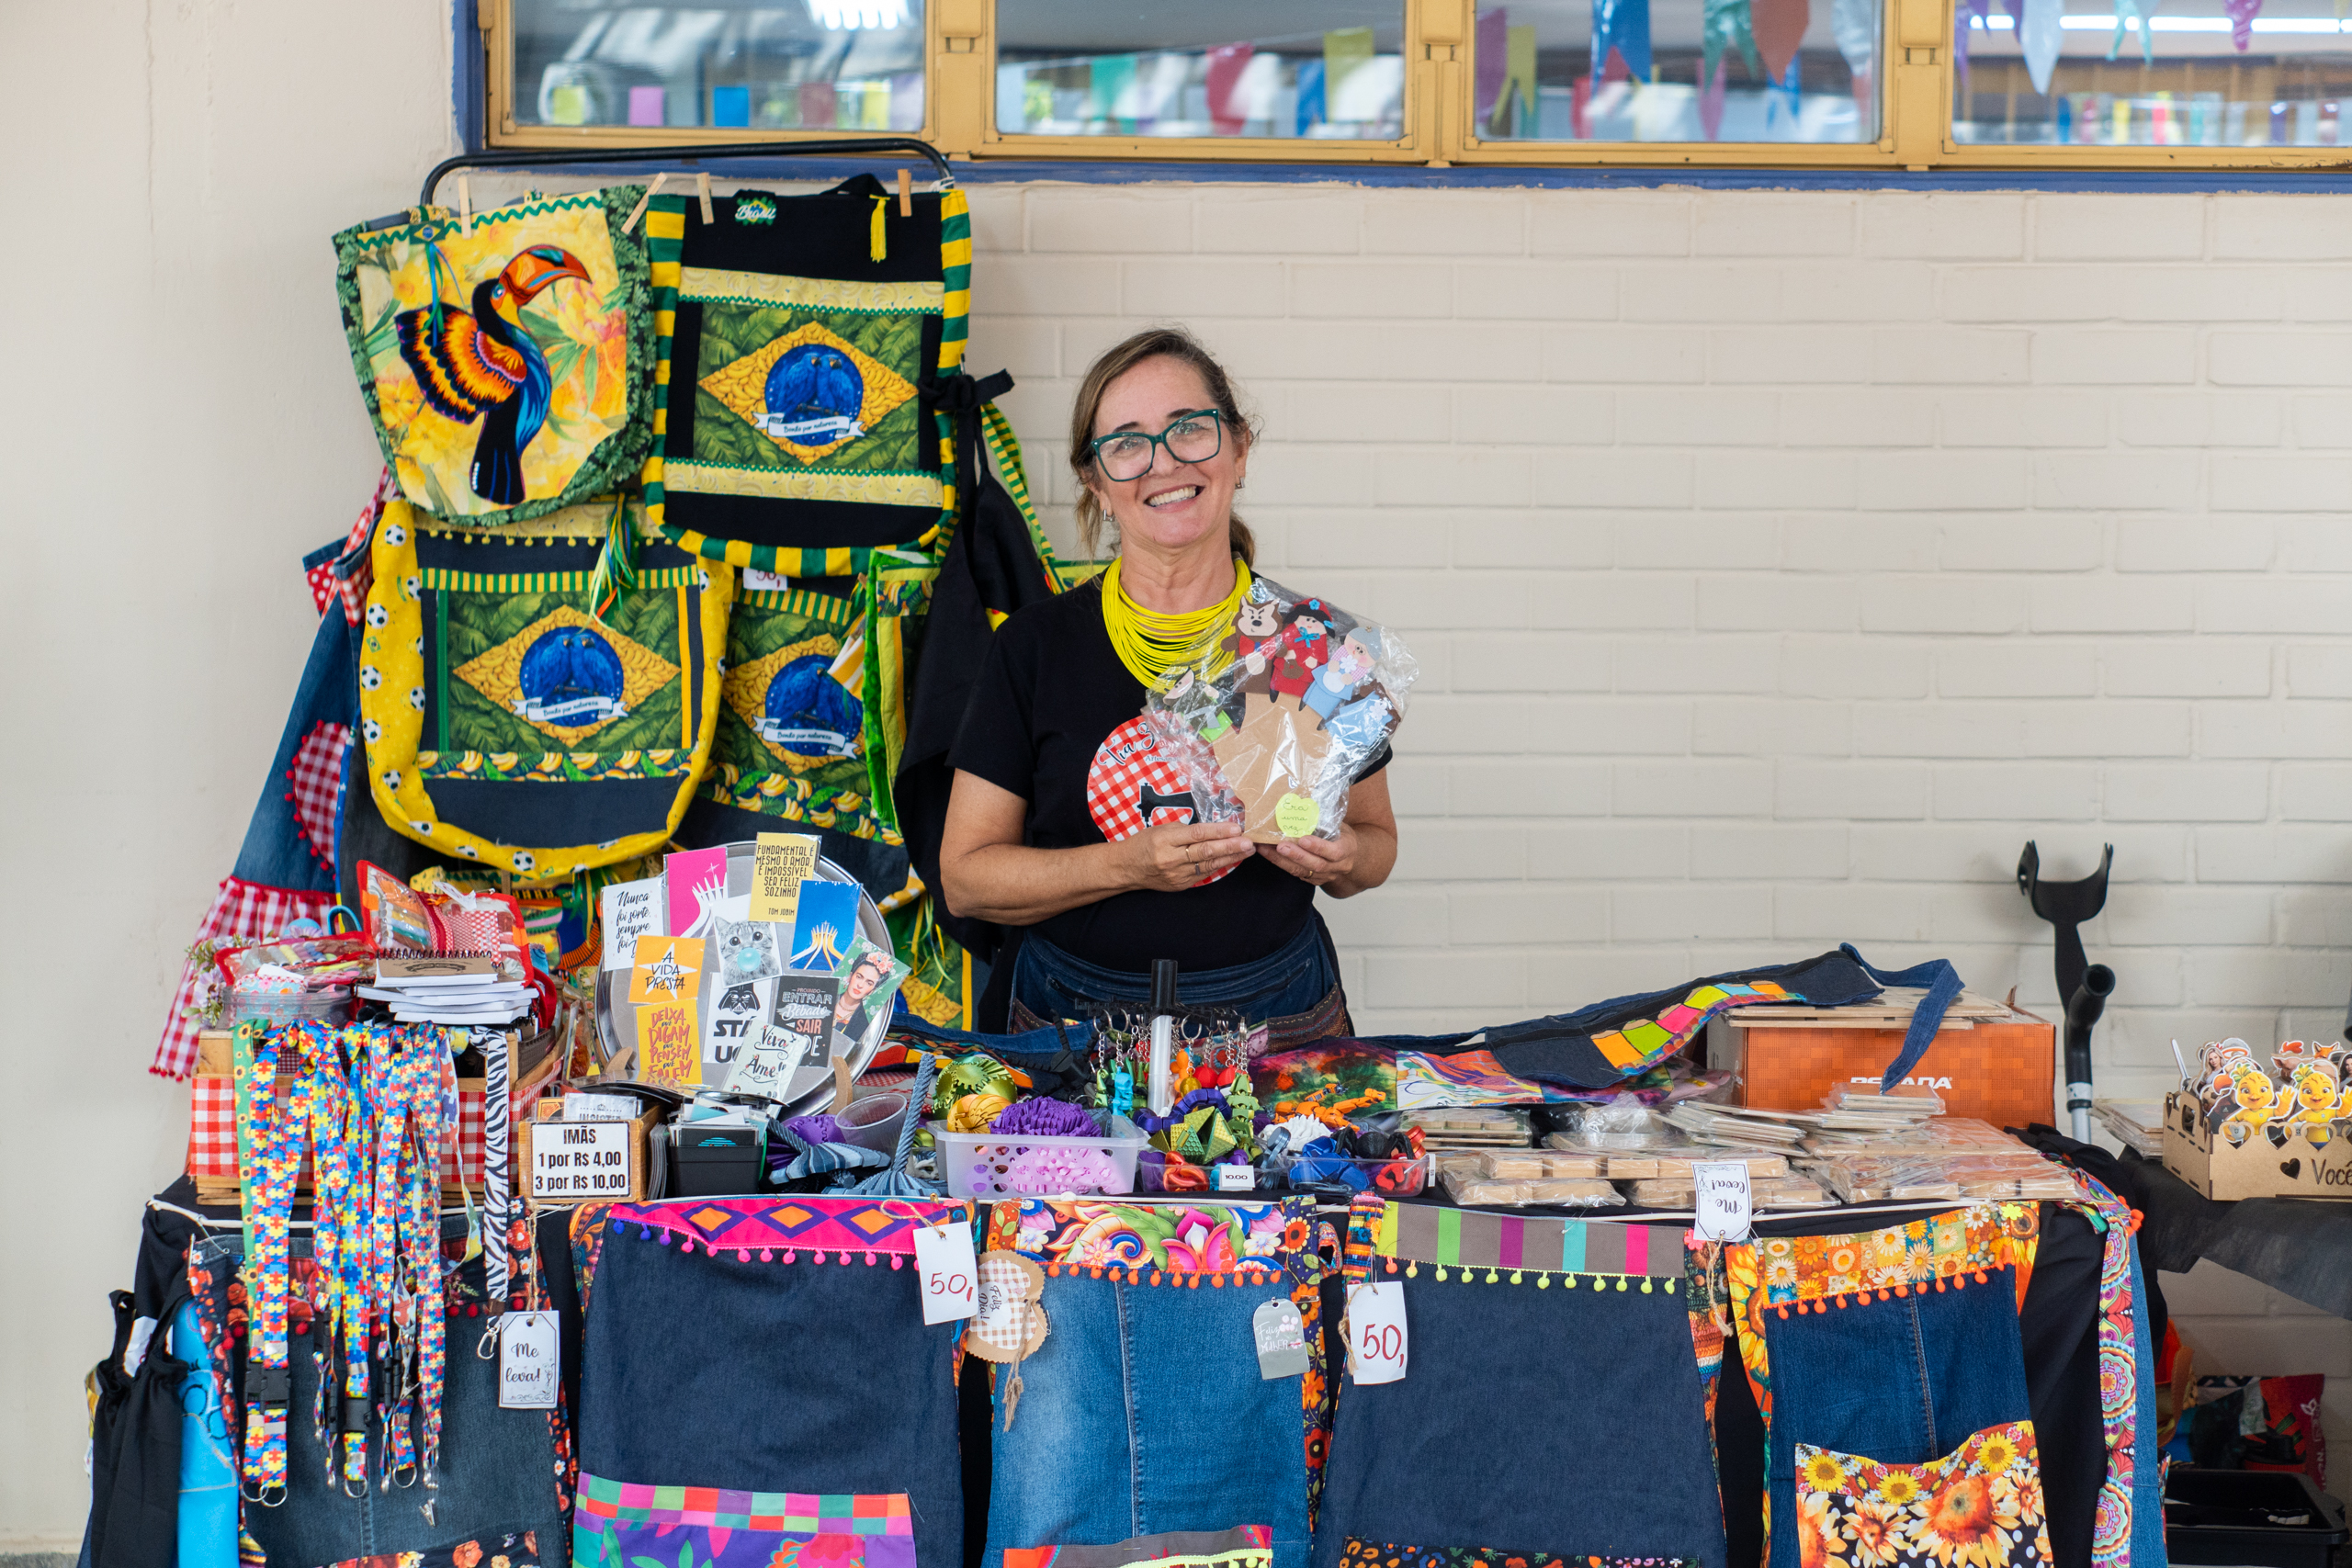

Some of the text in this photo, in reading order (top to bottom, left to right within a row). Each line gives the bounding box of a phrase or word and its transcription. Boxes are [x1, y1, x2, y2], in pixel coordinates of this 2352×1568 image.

[735, 204, 776, 220] Brasil
[1096, 739, 1136, 766] Tia
[1283, 798, 1308, 811] Era
[1283, 824, 1303, 836] vez
[757, 845, 815, 856] FUNDAMENTAL É
[755, 855, 812, 868] MESMO O AMOR,
[758, 864, 807, 876] É IMPOSSÍVEL
[763, 876, 799, 887] SER FELIZ
[616, 891, 650, 907] Nunca
[764, 886, 797, 897] SOZINHO
[616, 908, 628, 926] foi
[768, 908, 778, 916] TOM
[616, 923, 650, 939] sempre
[617, 936, 628, 953] foi
[662, 952, 674, 964] A
[651, 964, 681, 976] VIDA
[645, 976, 685, 990] PRESTA
[782, 992, 832, 1005] ENTRAR
[650, 1007, 686, 1028] DEIXA
[781, 1004, 828, 1021] Bêbado
[796, 1019, 822, 1034] SAIR
[647, 1023, 690, 1048] DIGAM
[761, 1026, 788, 1048] Viva
[649, 1043, 692, 1063] PENSEM
[745, 1055, 777, 1077] Ame
[563, 1125, 596, 1145] IMÃS
[538, 1151, 621, 1169] 1 por R$ 4,00
[536, 1174, 626, 1191] 3 por R$ 10,00
[1712, 1179, 1746, 1193] leva!
[1715, 1198, 1742, 1214] Me
[930, 1271, 974, 1302] 50,
[989, 1285, 1003, 1312] Feliz
[1255, 1321, 1281, 1341] Feliz
[511, 1342, 539, 1358] Me
[1363, 1324, 1405, 1368] 50,
[505, 1367, 540, 1382] leva!
